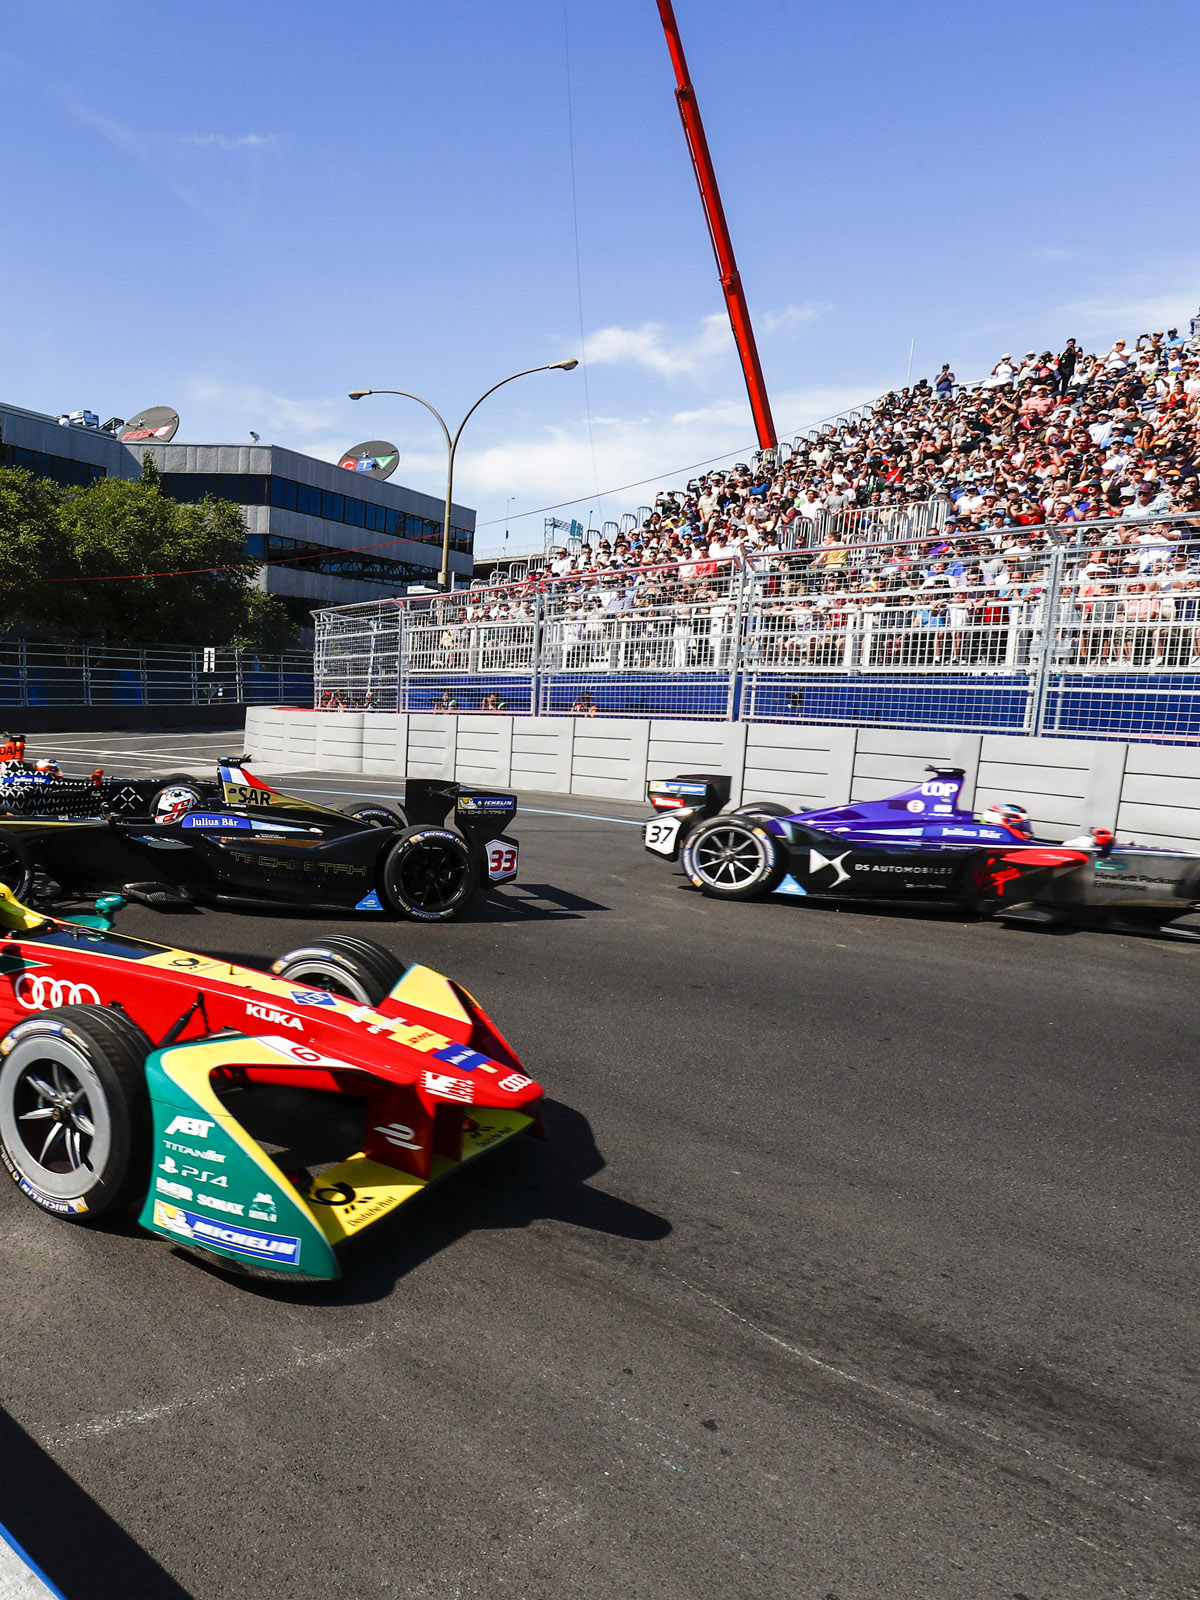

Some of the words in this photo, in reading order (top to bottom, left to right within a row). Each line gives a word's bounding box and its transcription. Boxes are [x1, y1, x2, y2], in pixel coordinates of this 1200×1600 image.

[342, 458, 392, 470] CTV
[0, 746, 24, 756] DAM
[238, 787, 271, 805] SAR
[921, 782, 958, 796] LOP
[654, 797, 683, 807] TOTAL
[193, 818, 220, 827] Julius
[222, 818, 239, 827] Bär
[650, 825, 674, 844] 37
[942, 828, 977, 837] Julius
[979, 829, 1003, 838] Bär
[489, 849, 517, 872] 33
[854, 863, 870, 871] DS
[872, 864, 953, 875] AUTOMOBILES
[1094, 871, 1139, 882] Hewlett
[1093, 881, 1148, 892] Enterprise
[246, 1003, 304, 1031] KUKA
[290, 1046, 322, 1062] 6
[164, 1115, 215, 1138] ABT
[181, 1164, 229, 1188] PS4
[21, 1183, 69, 1213] MICHELIN
[196, 1193, 245, 1216] SONAX
[347, 1204, 382, 1227] Deutsche
[379, 1195, 397, 1209] Post
[193, 1221, 297, 1255] MICHELIN
